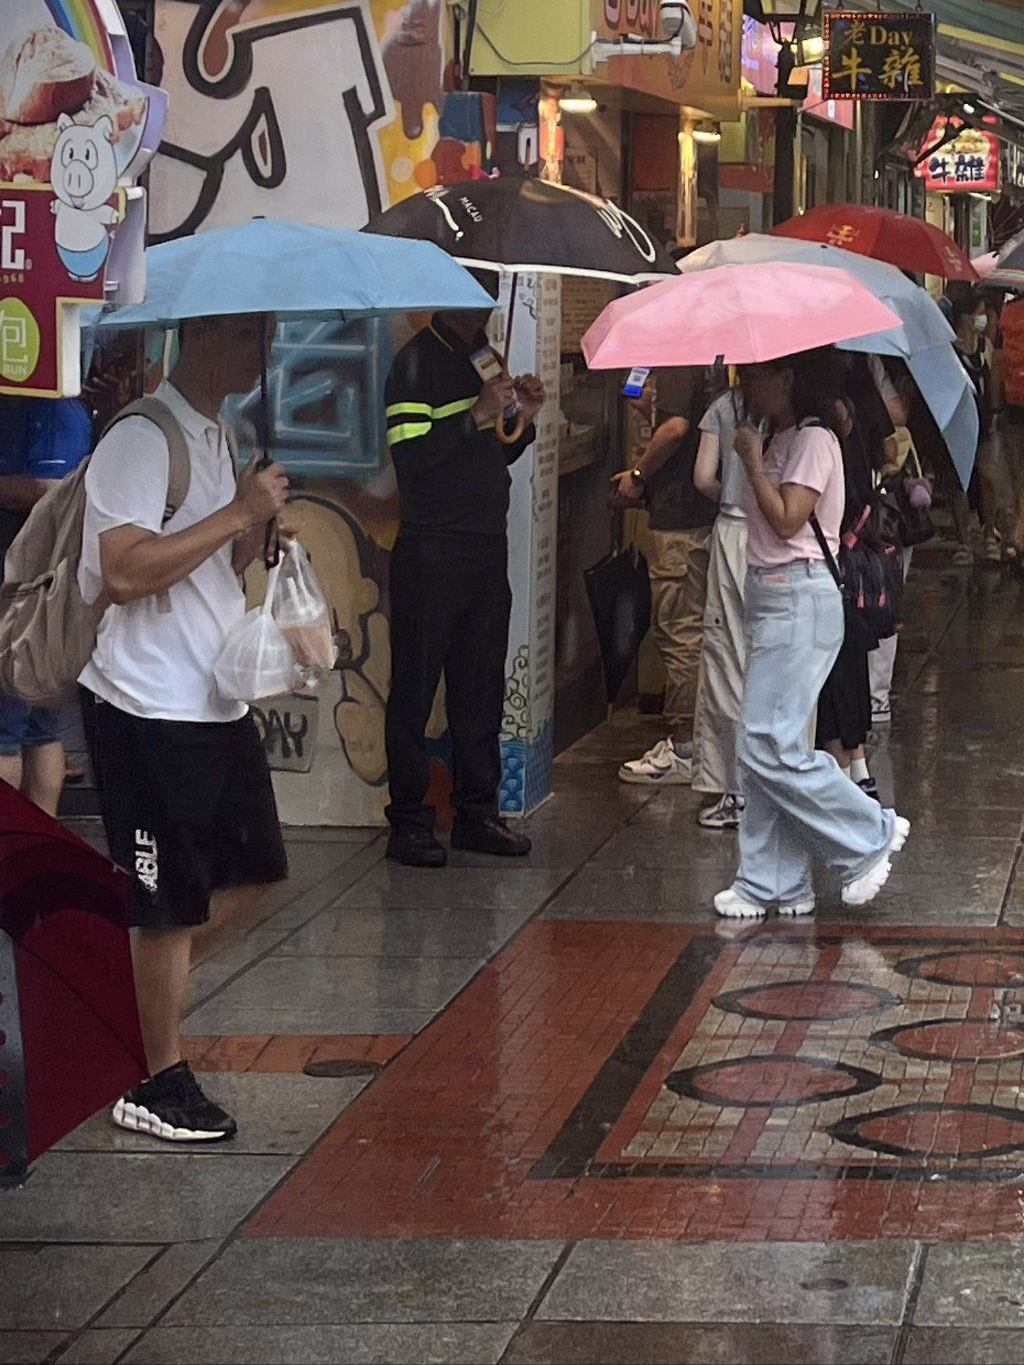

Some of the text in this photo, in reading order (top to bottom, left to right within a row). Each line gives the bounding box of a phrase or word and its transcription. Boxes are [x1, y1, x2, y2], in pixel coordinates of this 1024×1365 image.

[832, 46, 924, 93] 牛雜
[0, 273, 24, 282] 968
[3, 364, 27, 375] BUN
